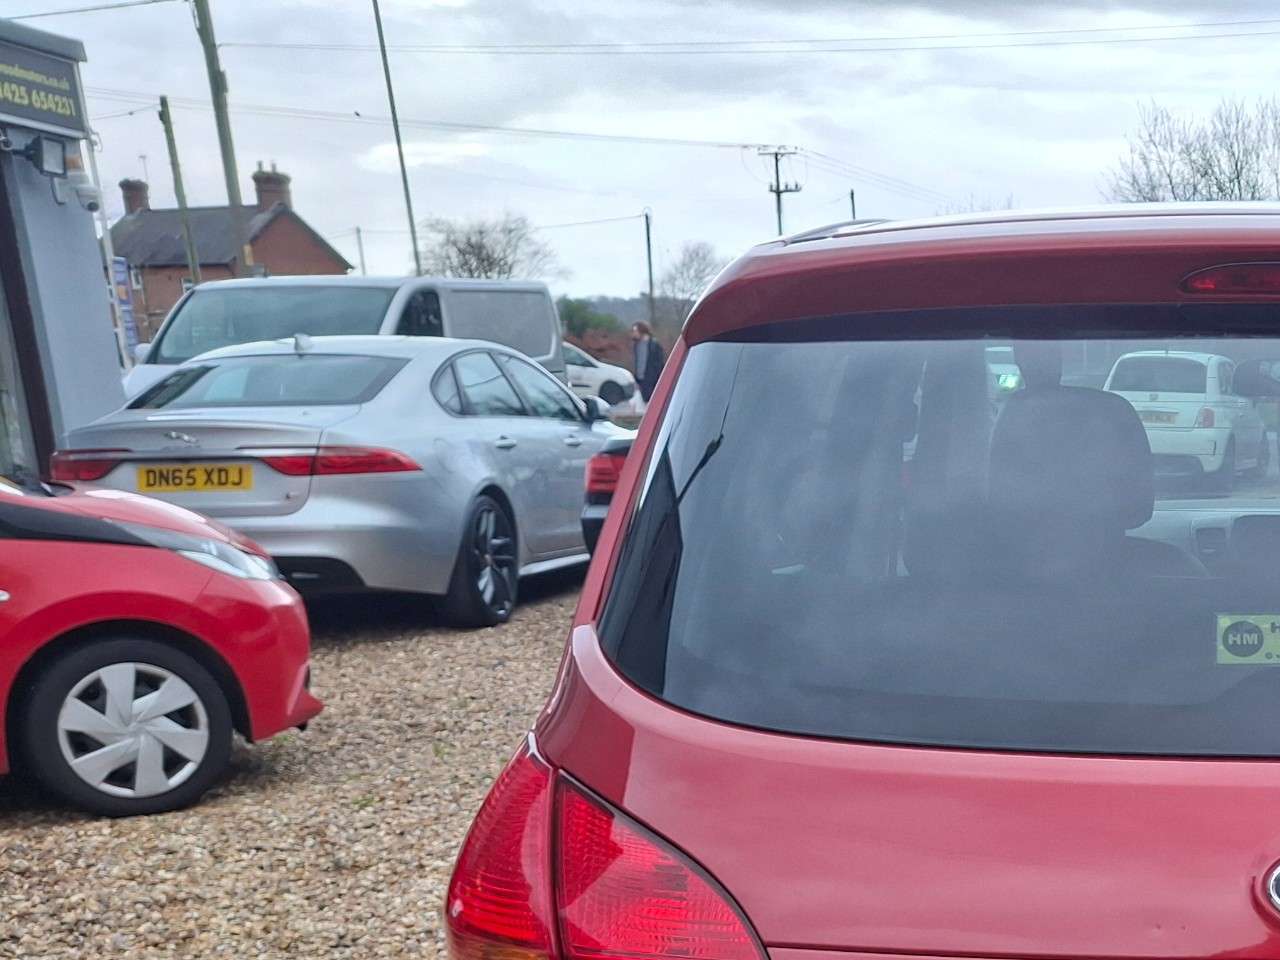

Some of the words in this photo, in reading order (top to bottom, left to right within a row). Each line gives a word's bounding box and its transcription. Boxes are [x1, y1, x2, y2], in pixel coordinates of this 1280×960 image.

[32, 89, 76, 117] 654231
[146, 467, 197, 488] DN65
[203, 467, 244, 487] XDJ
[1227, 632, 1259, 646] HM
